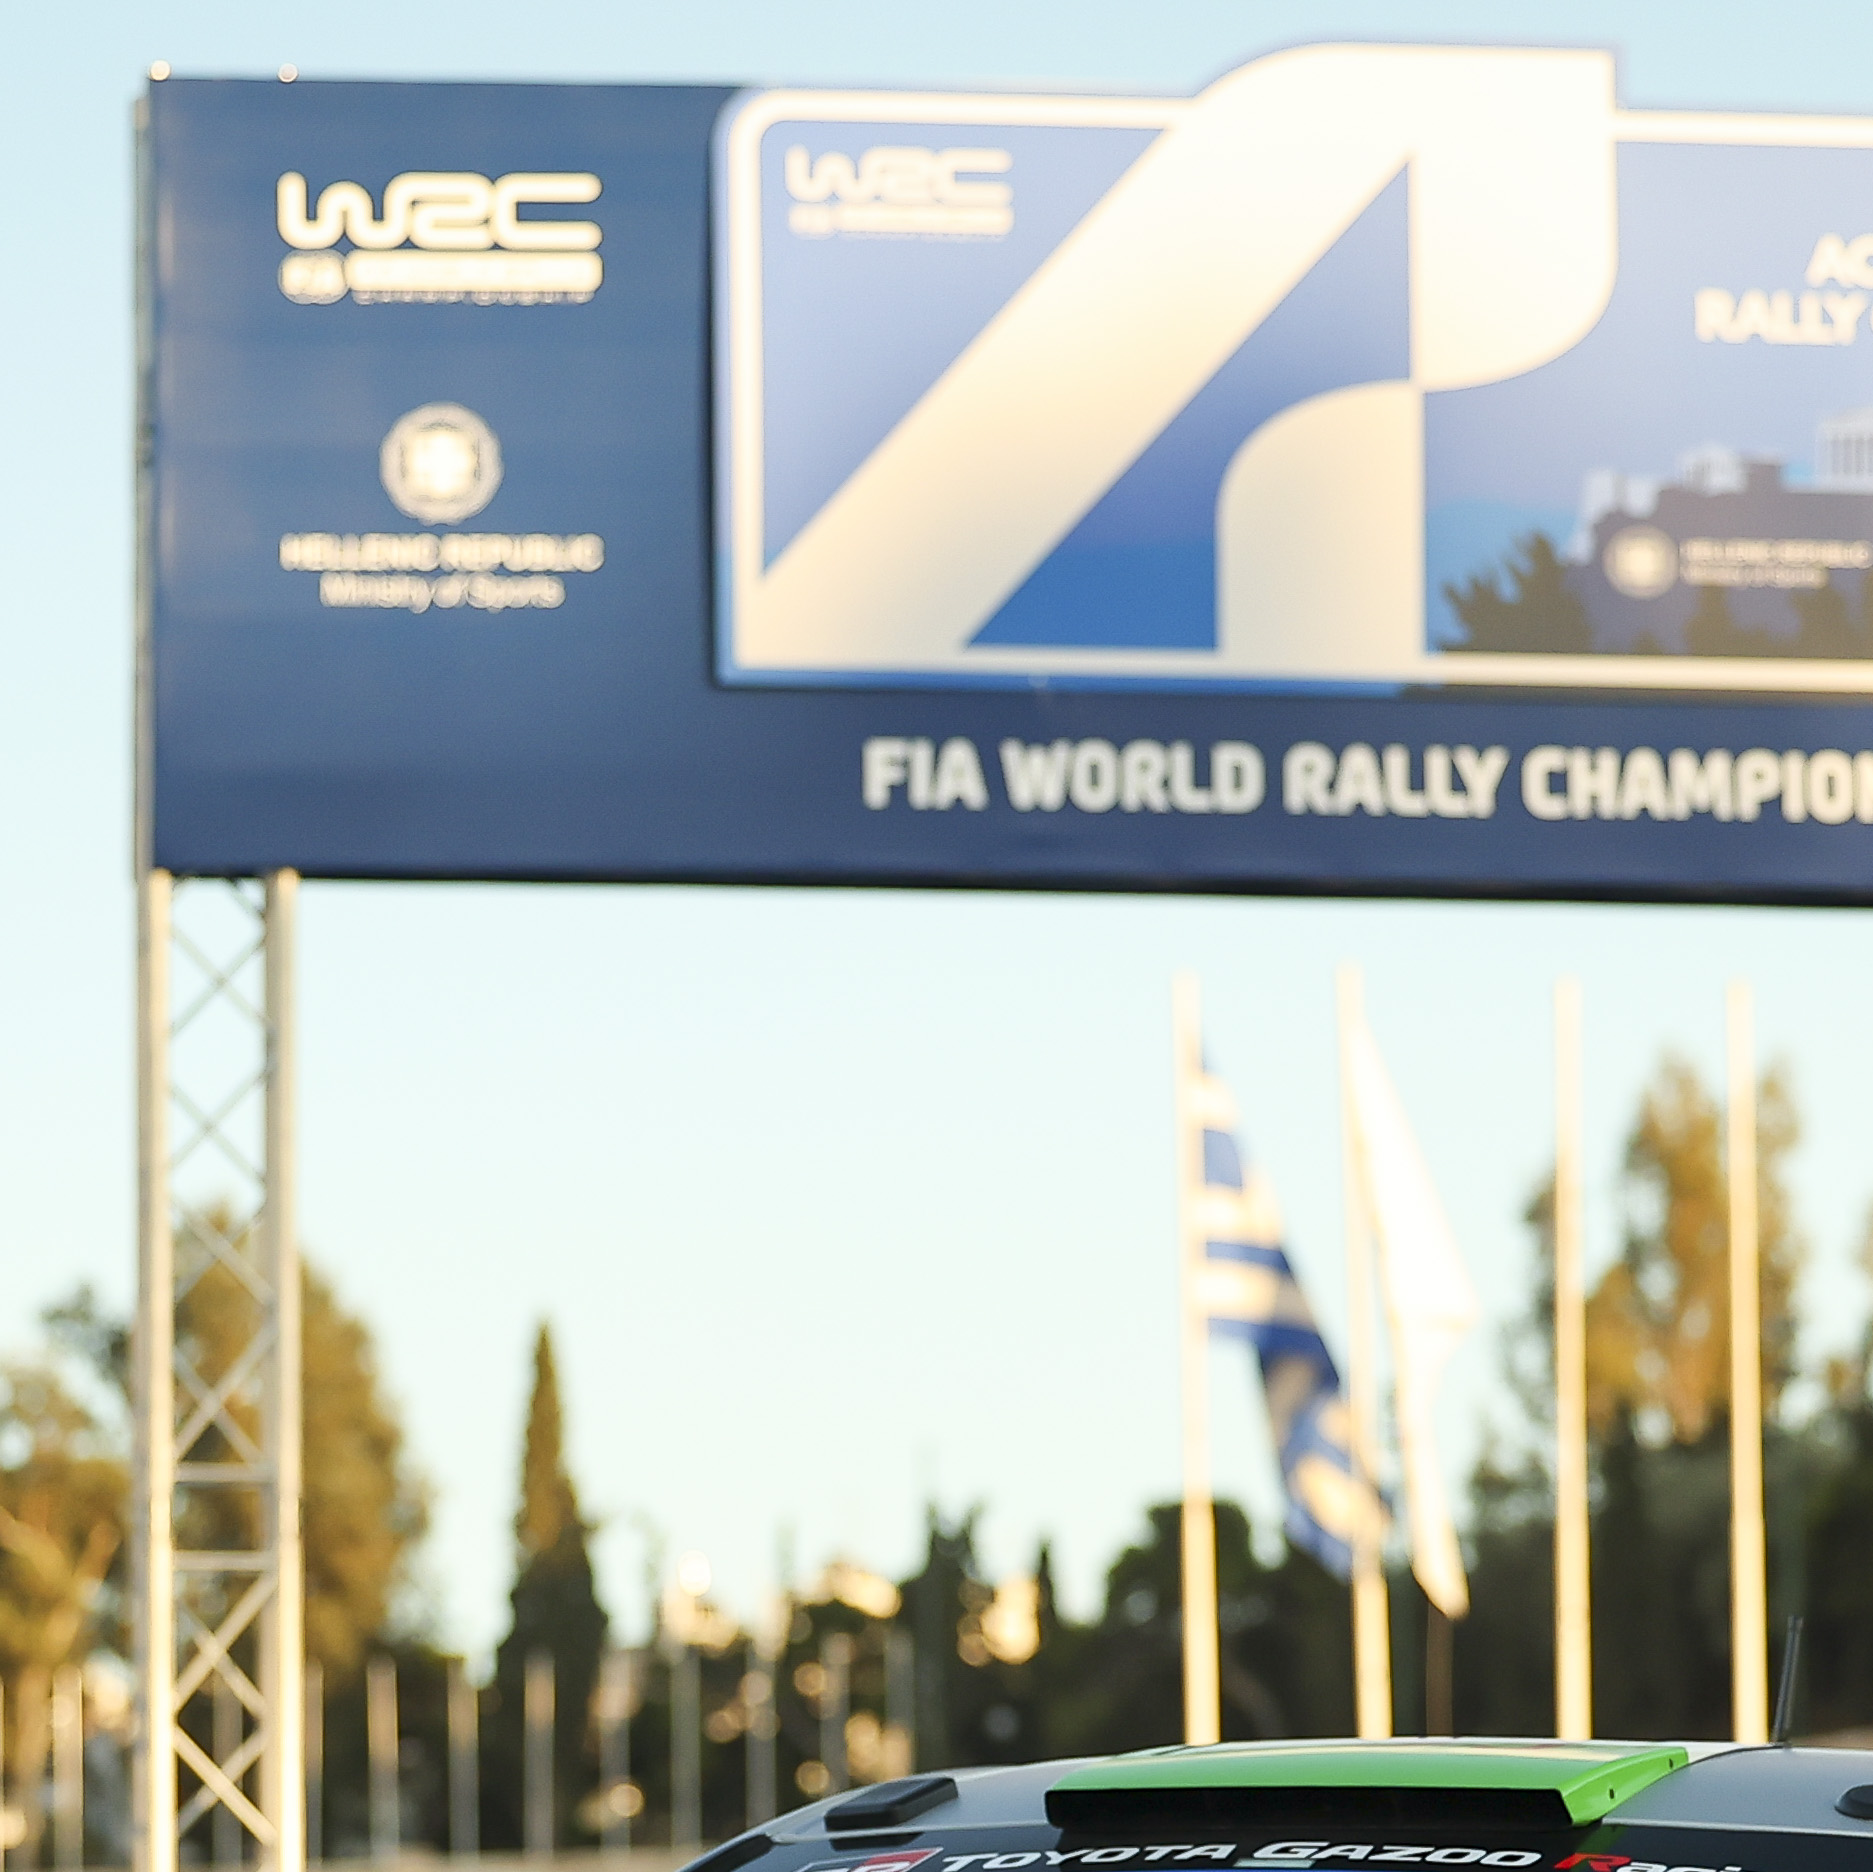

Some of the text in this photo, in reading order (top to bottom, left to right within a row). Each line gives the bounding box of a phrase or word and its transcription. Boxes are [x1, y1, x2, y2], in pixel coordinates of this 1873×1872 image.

[277, 171, 603, 249] WRC
[1695, 289, 1868, 346] RALLY
[860, 736, 990, 813] FIA
[999, 738, 1266, 816] WORLD
[1283, 741, 1511, 820] RALLY
[1252, 1841, 1542, 1869] GAZOO
